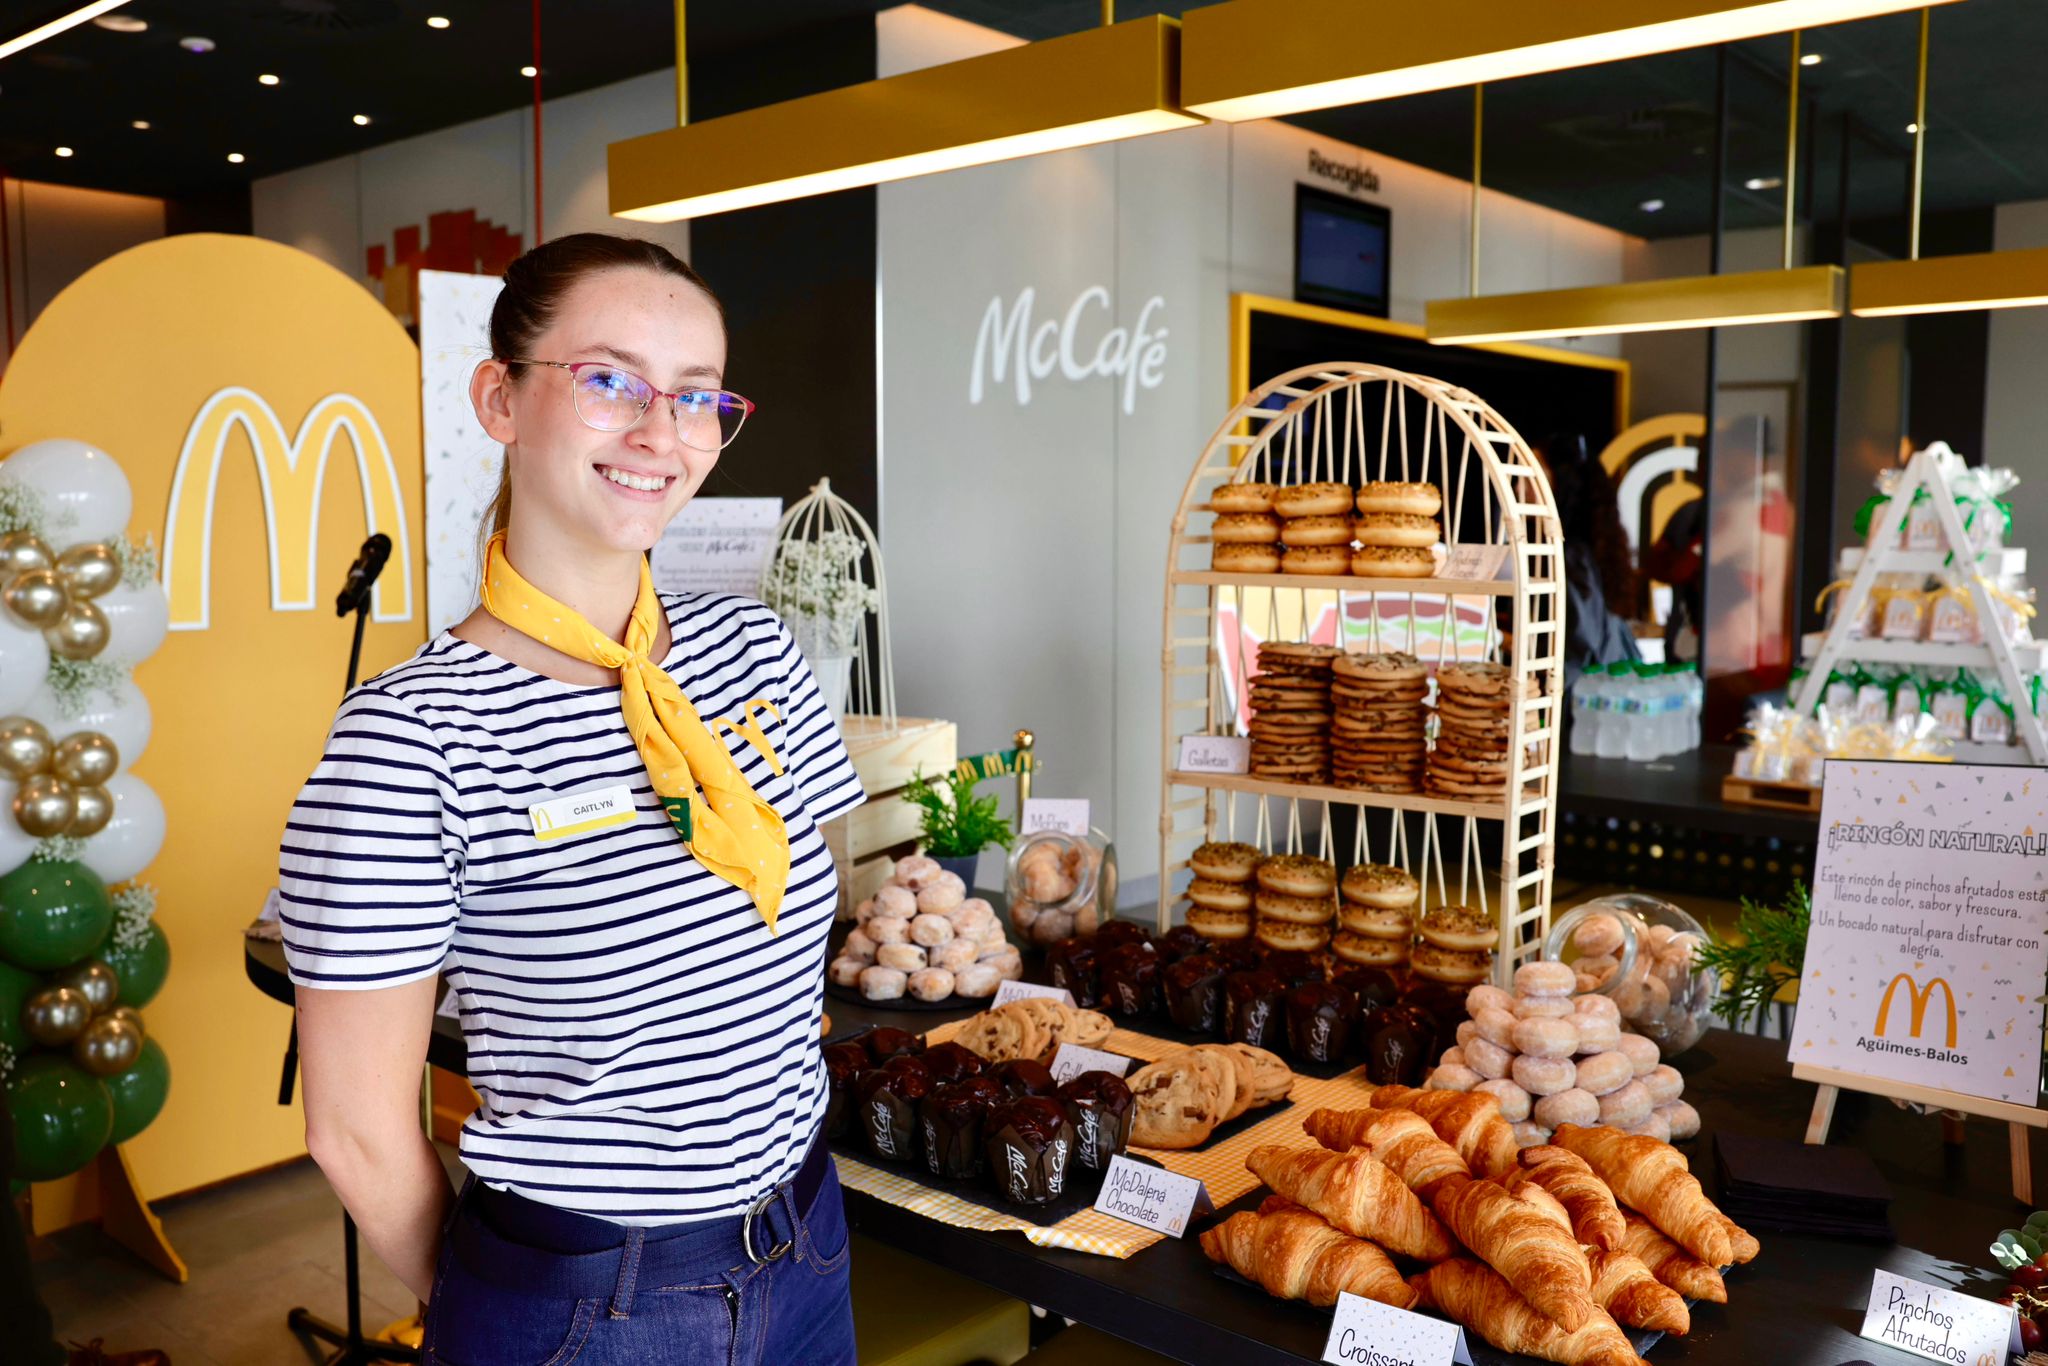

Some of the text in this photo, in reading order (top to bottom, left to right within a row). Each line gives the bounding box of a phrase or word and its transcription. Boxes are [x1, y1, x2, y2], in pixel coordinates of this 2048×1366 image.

[1308, 148, 1380, 194] Recogida
[969, 285, 1169, 415] McCafé
[573, 799, 614, 816] CAITLYN
[1827, 821, 2047, 856] ¡RINCÓN NATURAL!
[1820, 866, 1845, 884] Este
[1849, 874, 1884, 888] rincón
[1887, 871, 1901, 889] de
[1904, 874, 1951, 894] pinchos
[1954, 877, 2014, 900] afrutados
[1834, 884, 1861, 902] lleno
[1864, 887, 1878, 905] de
[1918, 893, 1951, 912] sabor
[1955, 903, 1962, 918] y
[1966, 896, 2022, 919] frescura.
[1818, 910, 1834, 927] Un
[1838, 911, 1878, 932] bocado
[1927, 928, 1953, 942] para
[1956, 924, 2013, 947] disfrutar
[2016, 937, 2039, 950] con
[1900, 936, 1944, 960] alegría.
[1856, 1036, 1969, 1065] Agüimes-Balos
[1110, 1166, 1166, 1203] McDalena
[1105, 1187, 1159, 1224] Chocolate
[1888, 1286, 1954, 1330] Pinchos
[1881, 1315, 1967, 1364] Afrutados
